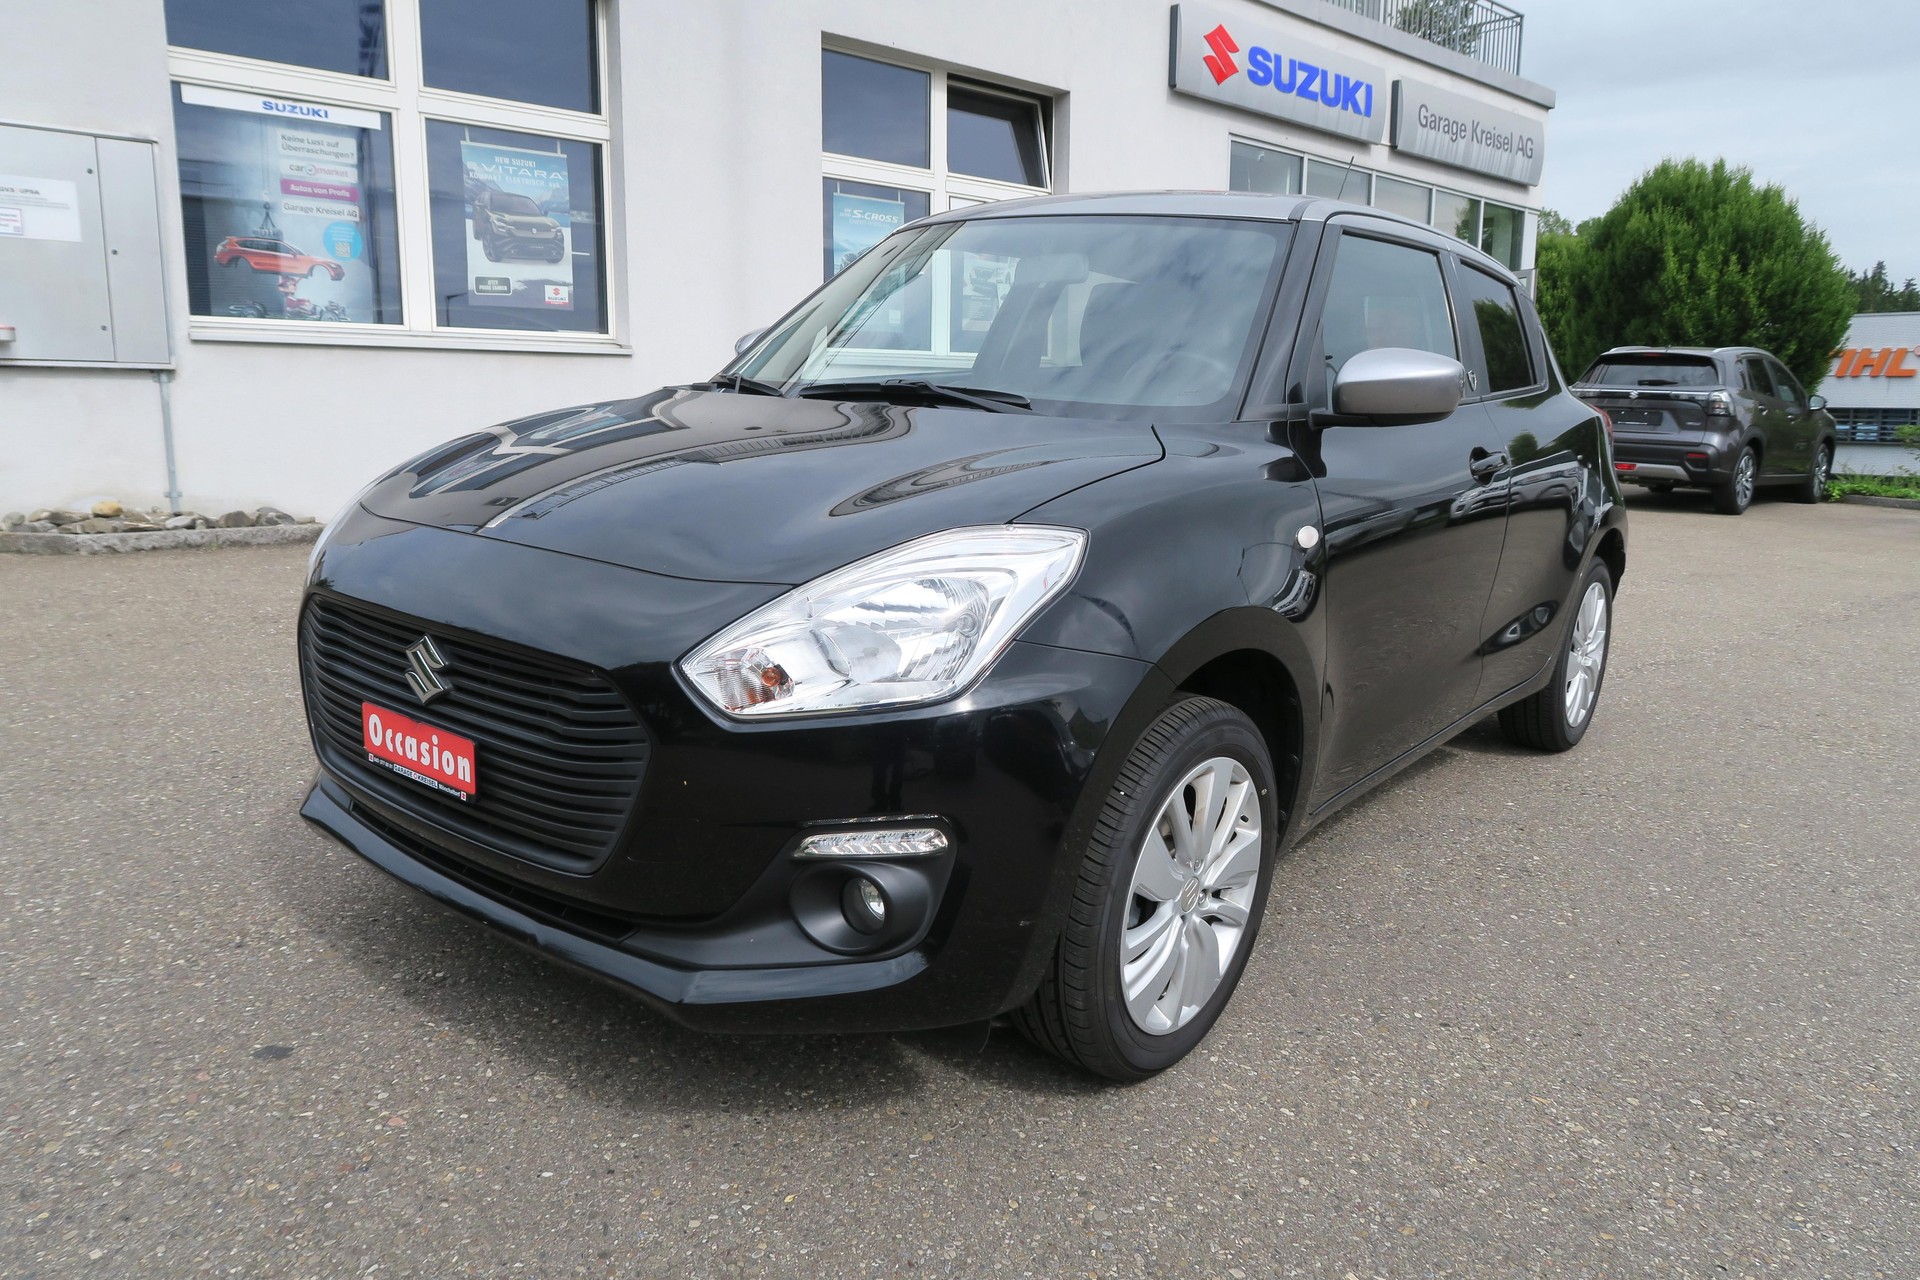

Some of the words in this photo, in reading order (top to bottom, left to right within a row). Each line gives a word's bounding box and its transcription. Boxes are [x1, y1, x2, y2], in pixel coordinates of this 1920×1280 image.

[1246, 46, 1374, 118] SUZUKI
[262, 101, 329, 119] SUZUKI
[1417, 103, 1467, 142] Garage
[1471, 119, 1513, 151] Kreisel
[1515, 134, 1534, 159] AG
[280, 134, 305, 143] Keine
[306, 138, 325, 146] Lust
[511, 158, 536, 168] SUZUKI
[313, 187, 328, 195] von
[283, 202, 314, 214] Garage
[315, 206, 345, 217] Kreisel
[346, 209, 358, 218] AG
[368, 713, 471, 783] Occasion
